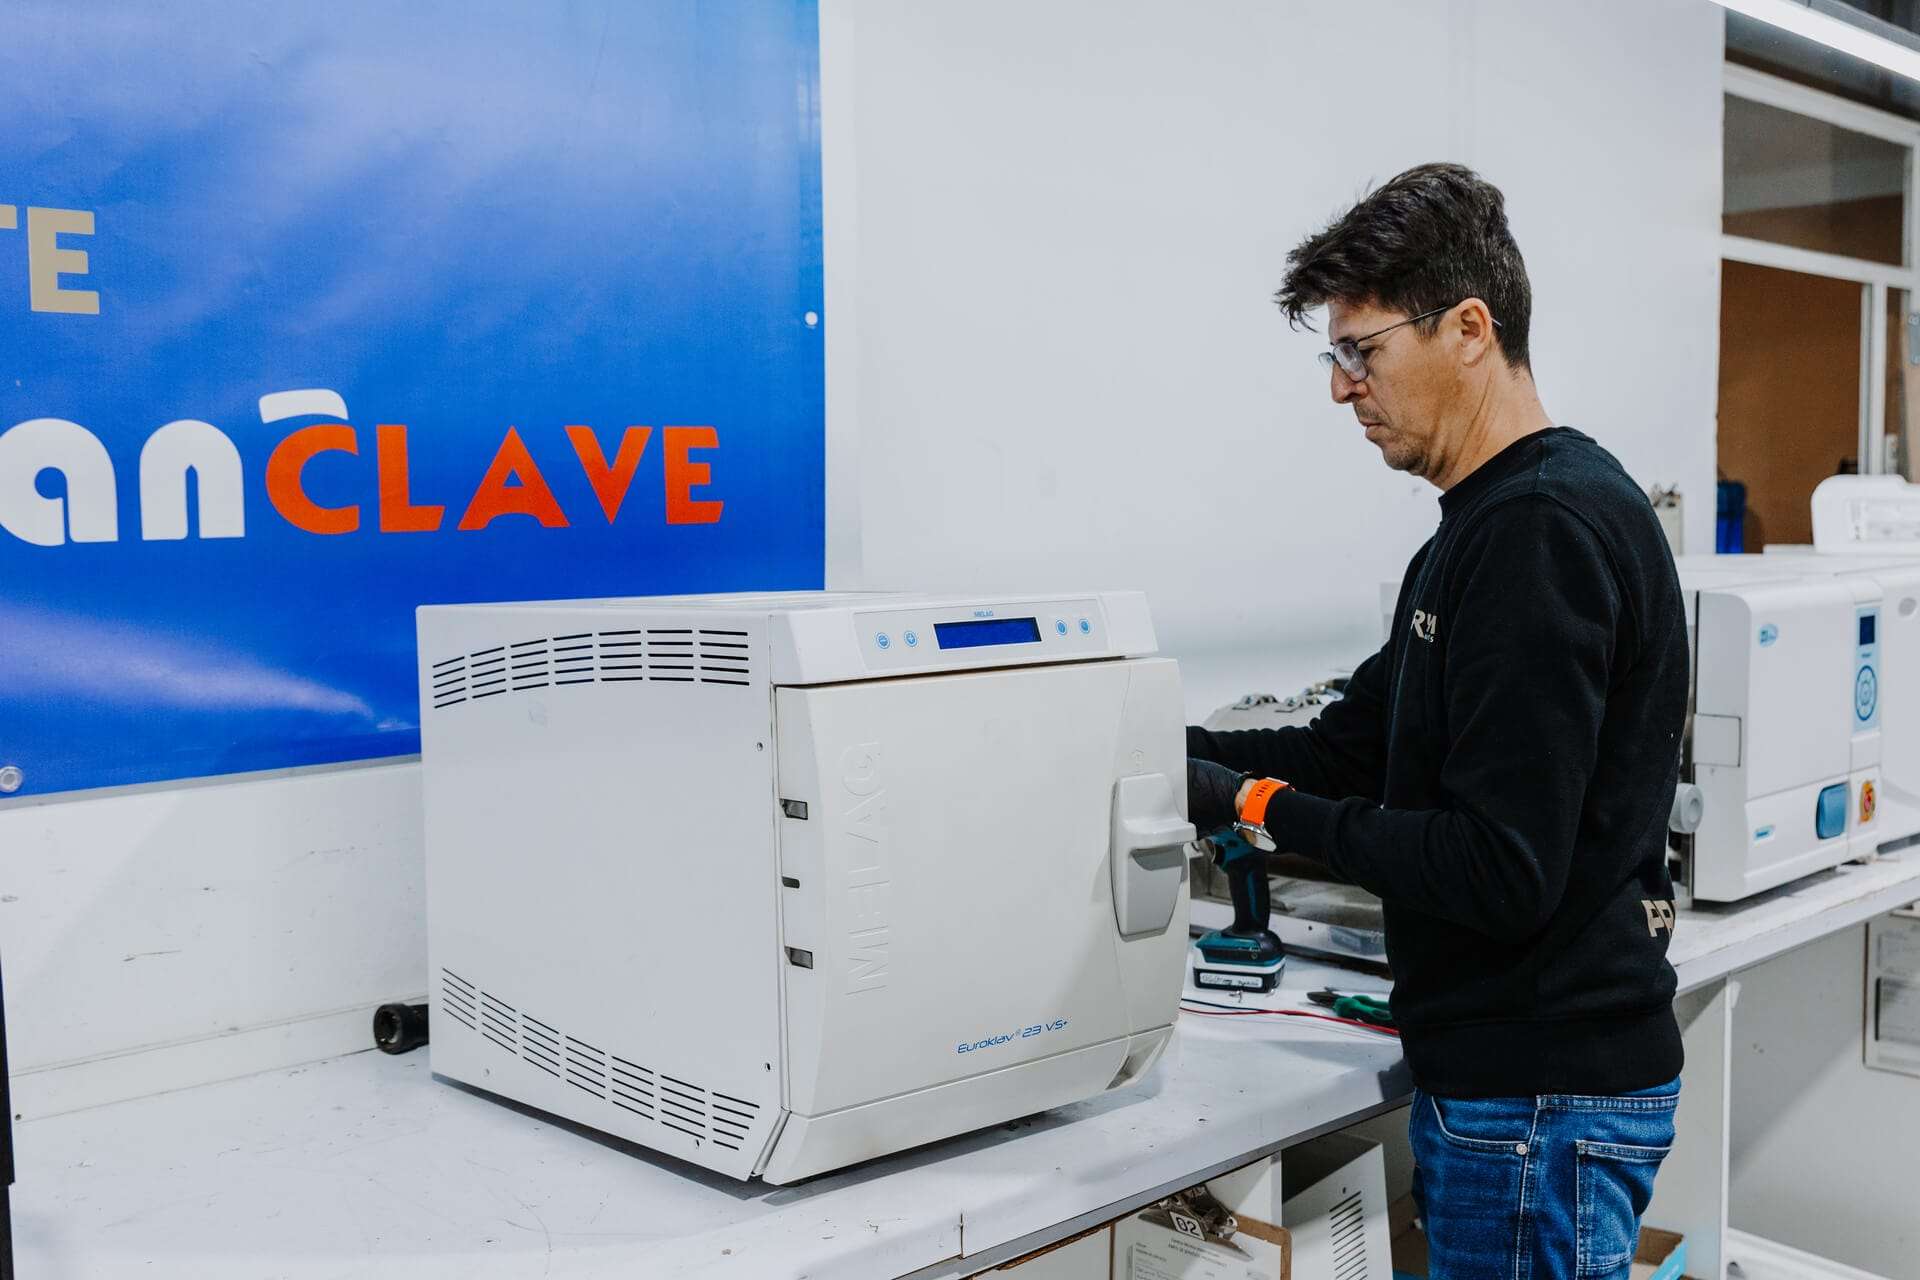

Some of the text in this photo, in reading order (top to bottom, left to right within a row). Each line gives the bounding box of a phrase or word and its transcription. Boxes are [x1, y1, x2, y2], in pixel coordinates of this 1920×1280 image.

[0, 204, 100, 315] E
[1022, 1025, 1042, 1038] 23
[1175, 1216, 1201, 1237] 02
